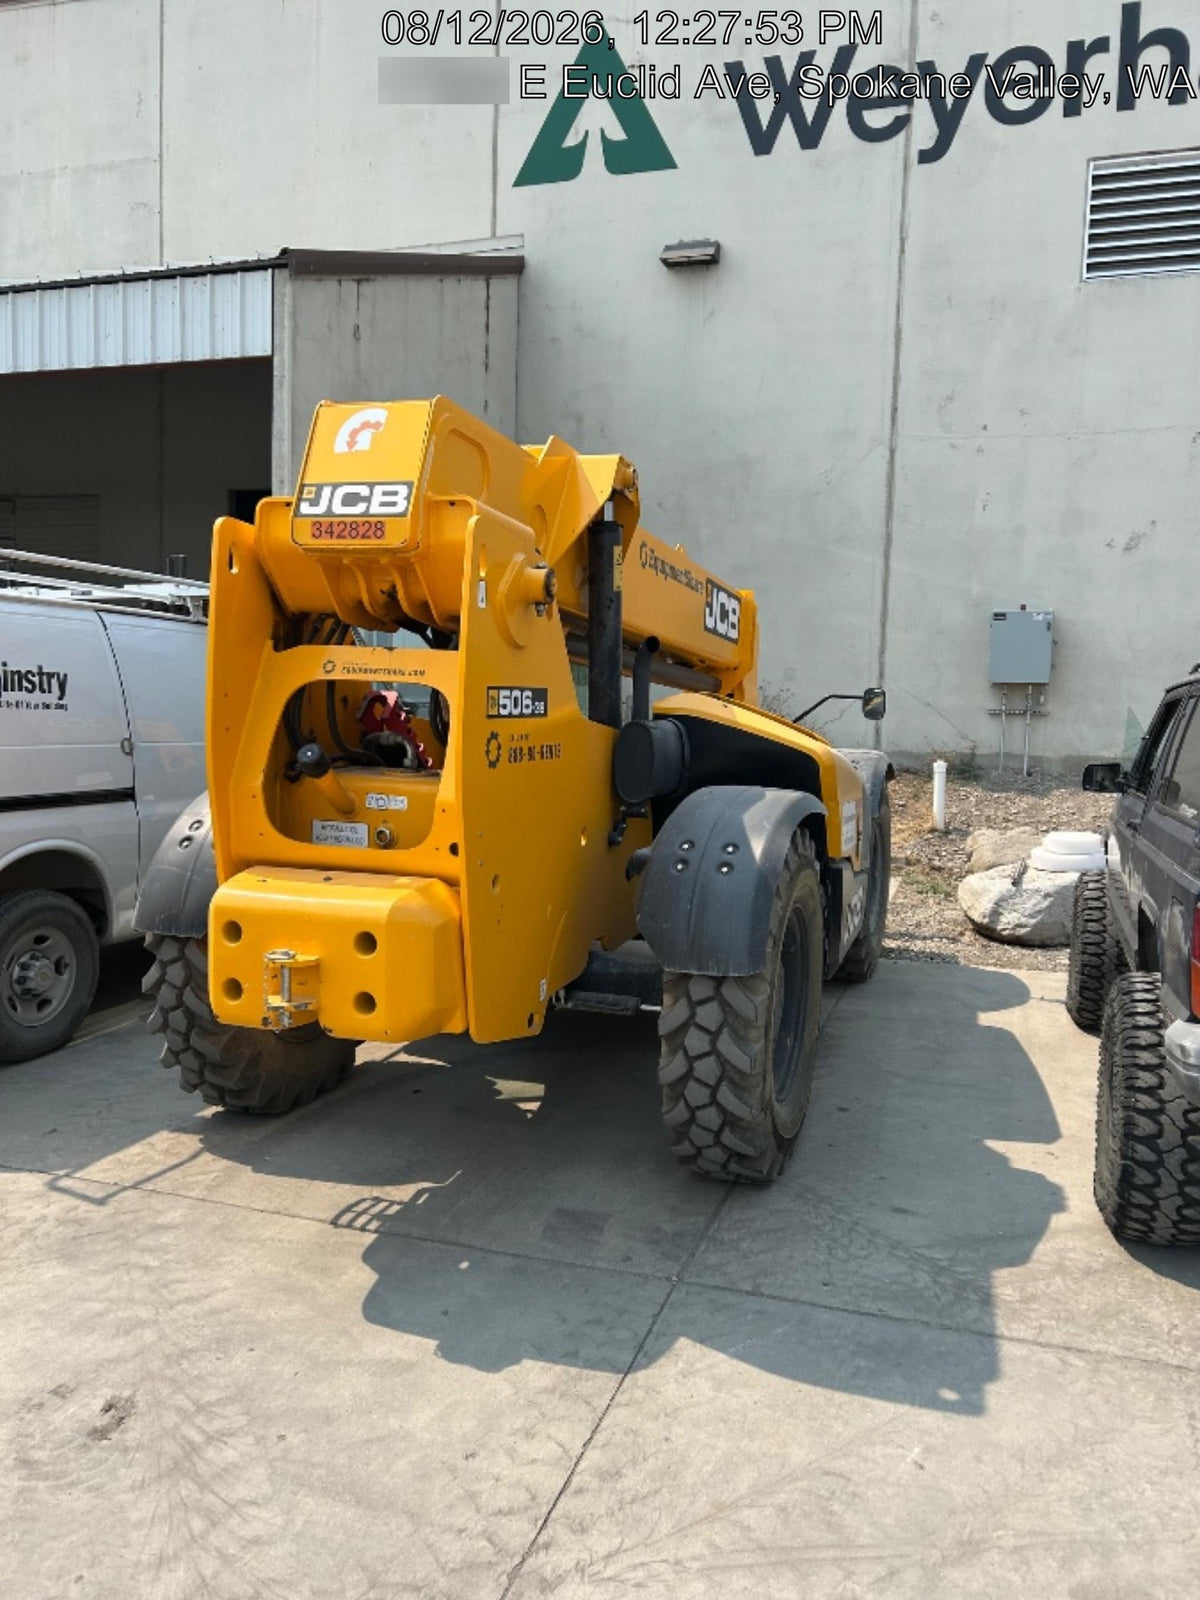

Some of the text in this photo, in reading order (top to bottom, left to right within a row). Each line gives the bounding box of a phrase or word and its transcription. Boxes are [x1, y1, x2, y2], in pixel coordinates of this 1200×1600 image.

[723, 1, 1200, 164] Weyerh
[299, 484, 409, 515] JCB
[312, 520, 385, 540] 342828
[705, 587, 740, 640] JCB
[0, 661, 68, 701] instry
